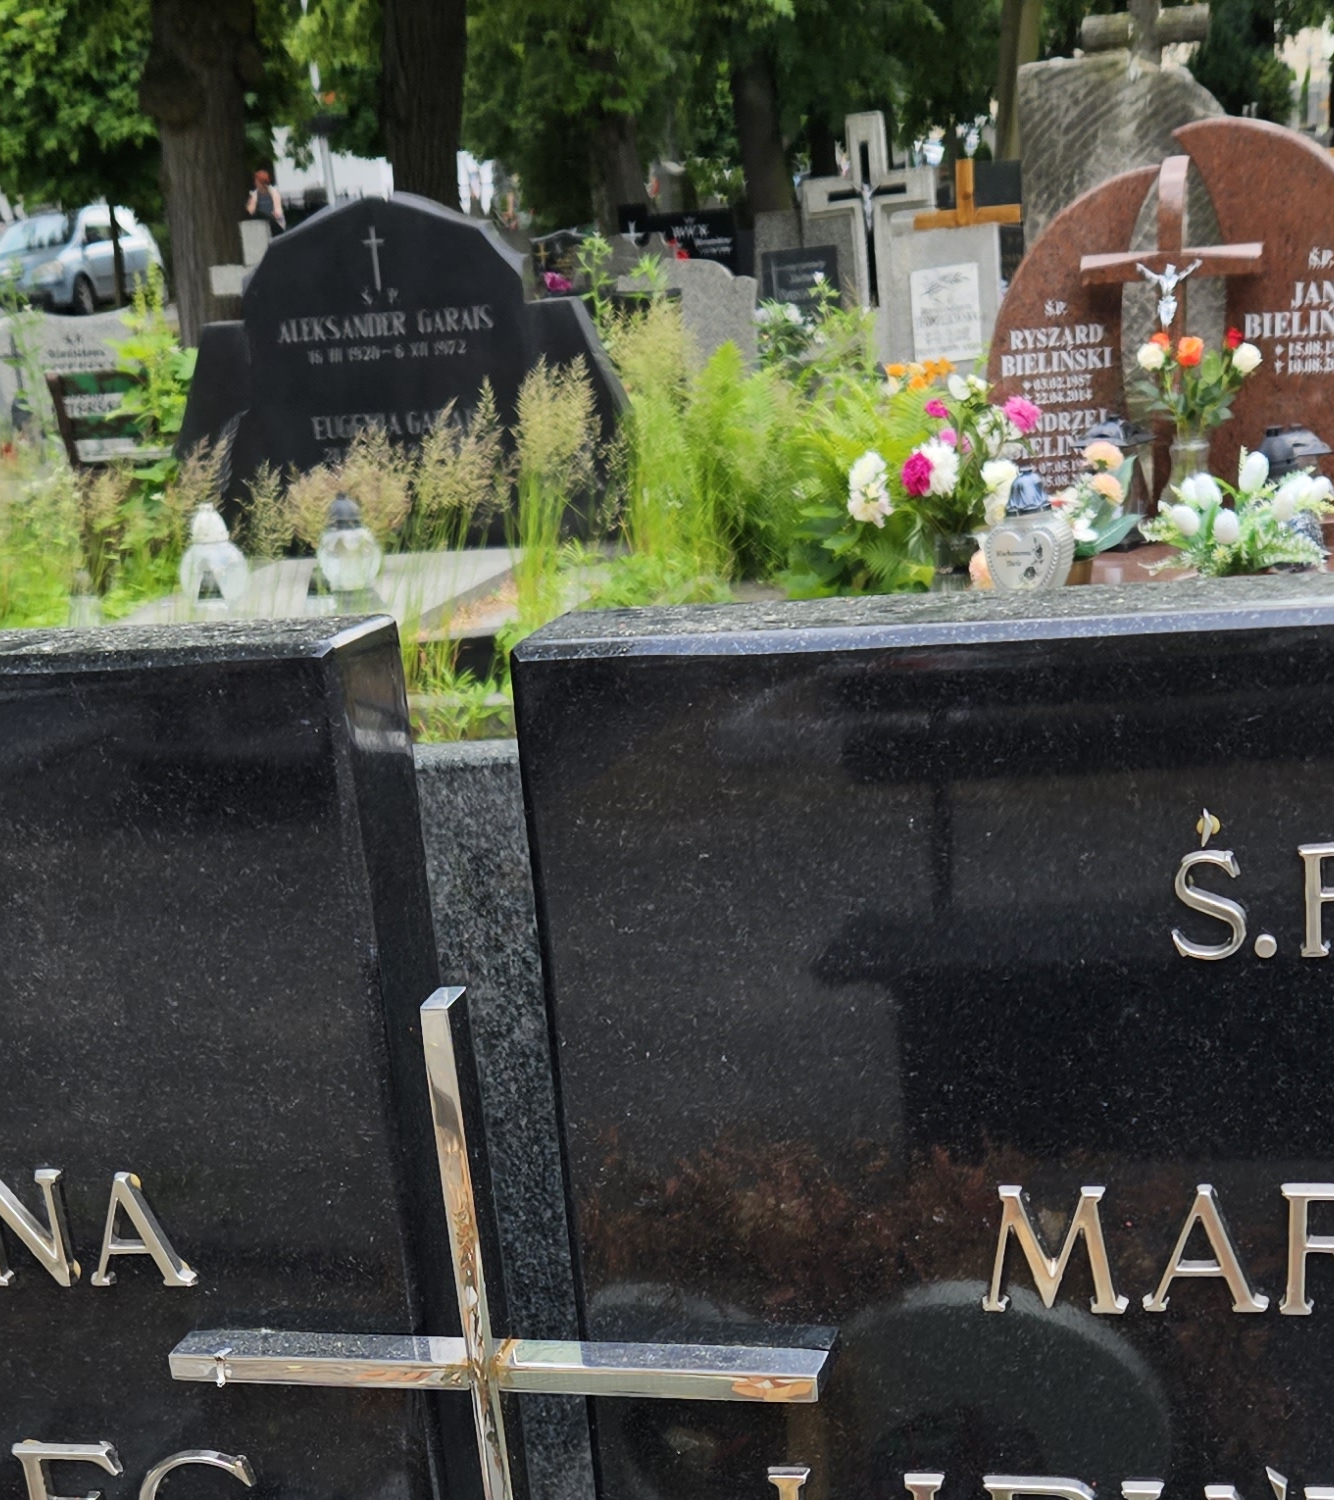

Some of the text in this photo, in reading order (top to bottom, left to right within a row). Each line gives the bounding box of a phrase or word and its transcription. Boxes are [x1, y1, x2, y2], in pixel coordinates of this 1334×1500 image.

[277, 311, 407, 344] ALEKSANDER
[1010, 323, 1105, 350] RYSZARD
[1001, 346, 1113, 377] BIELIŃSKI
